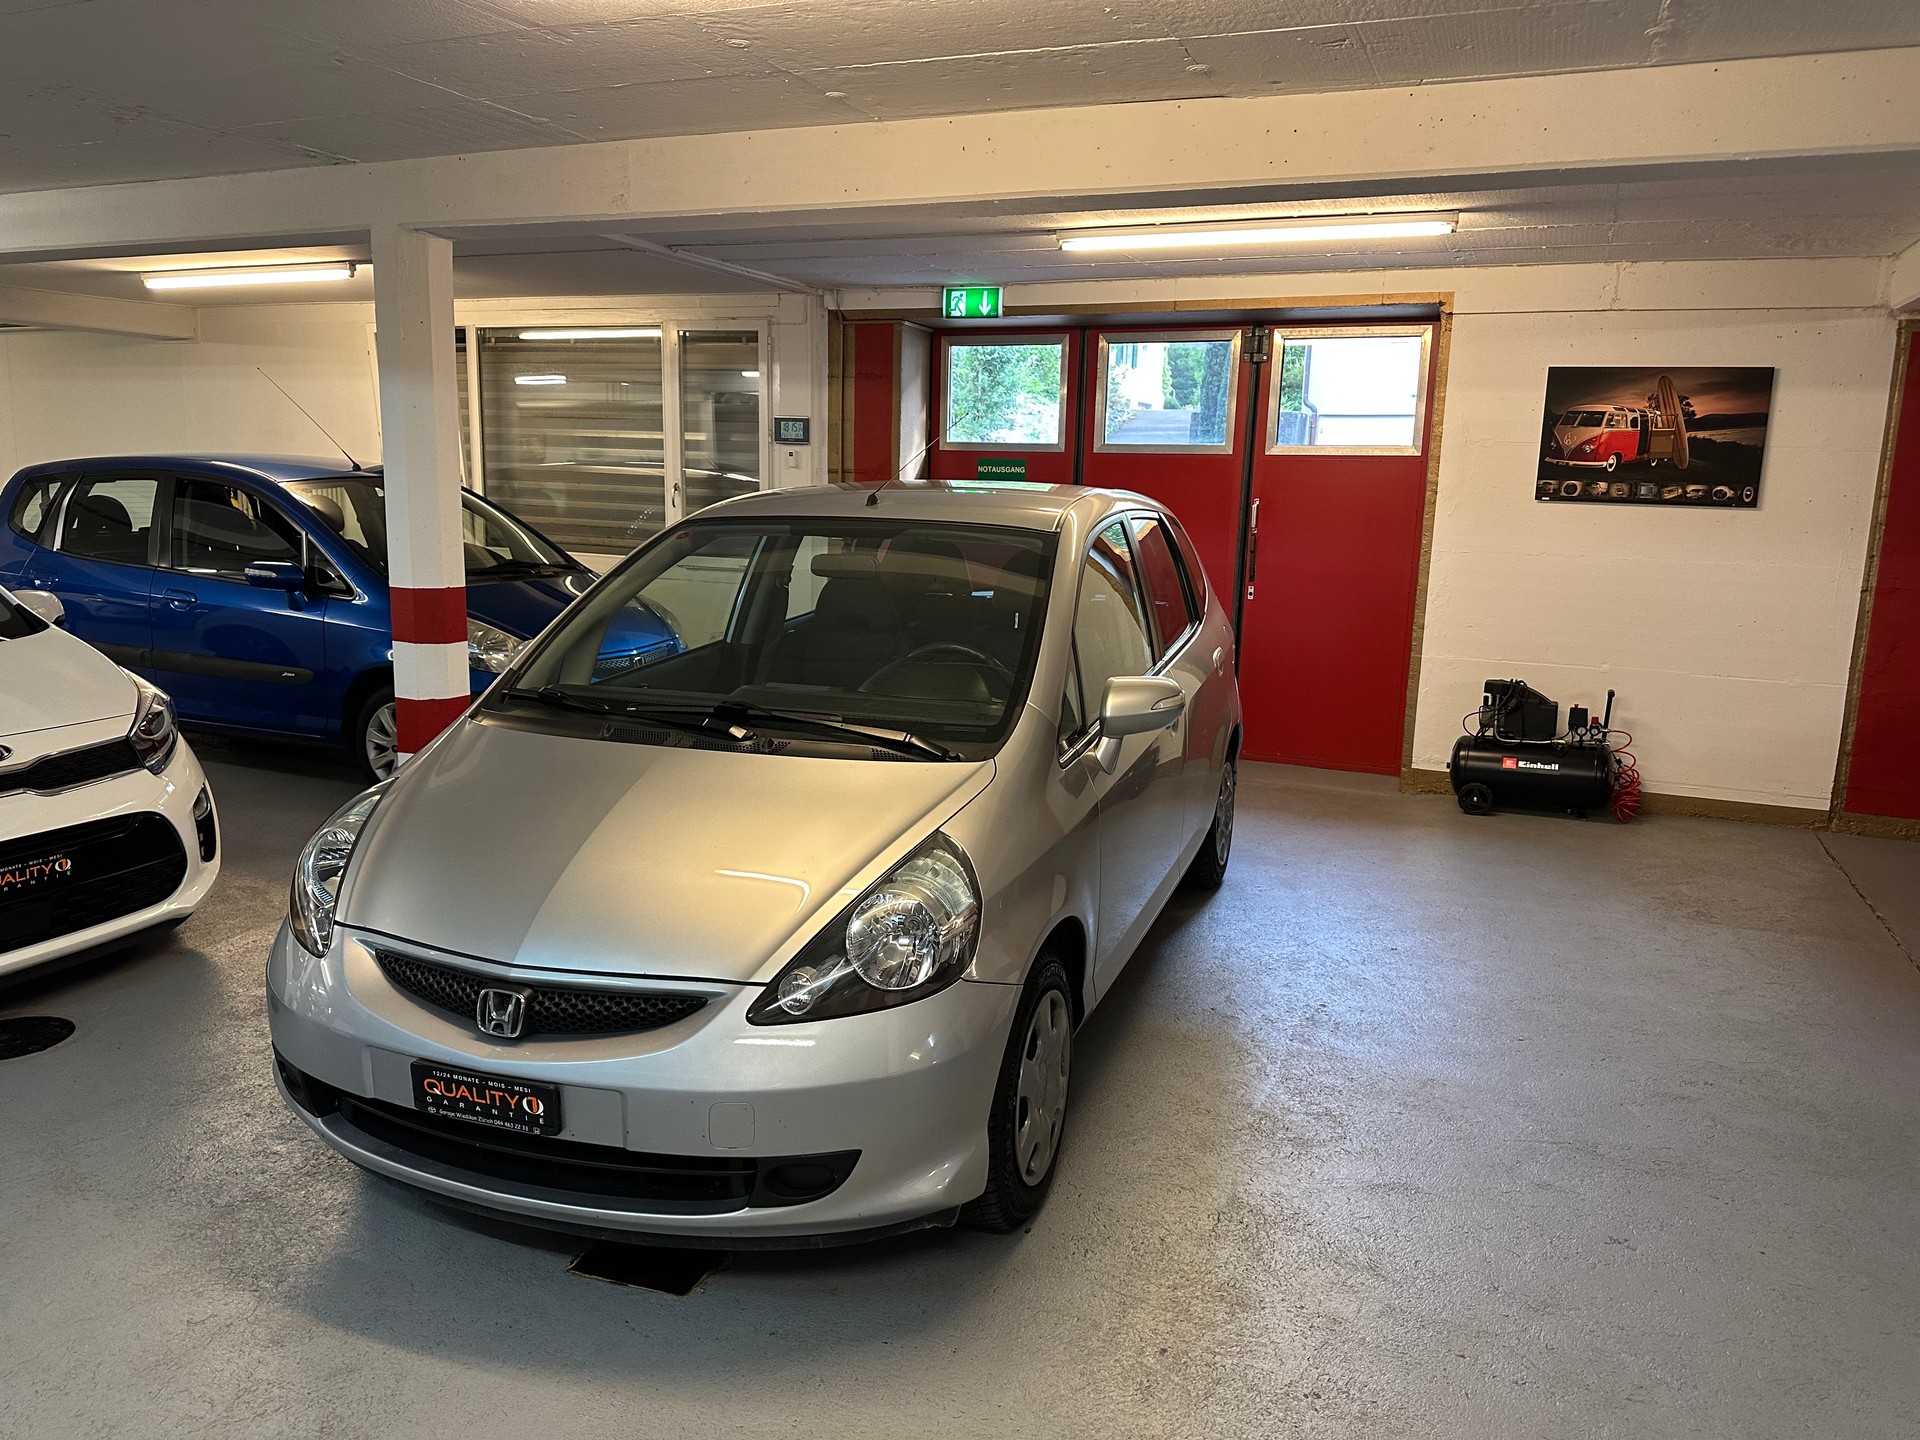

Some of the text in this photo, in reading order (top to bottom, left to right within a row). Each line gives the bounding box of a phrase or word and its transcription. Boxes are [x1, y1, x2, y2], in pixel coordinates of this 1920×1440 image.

[1518, 761, 1559, 771] Einhell
[423, 1078, 520, 1110] QUALITY
[432, 1070, 451, 1079] 12/24
[453, 1074, 480, 1084] MONATE
[488, 1081, 506, 1089] MOIS
[514, 1085, 531, 1094] MESI
[426, 1095, 545, 1125] GARANTIE
